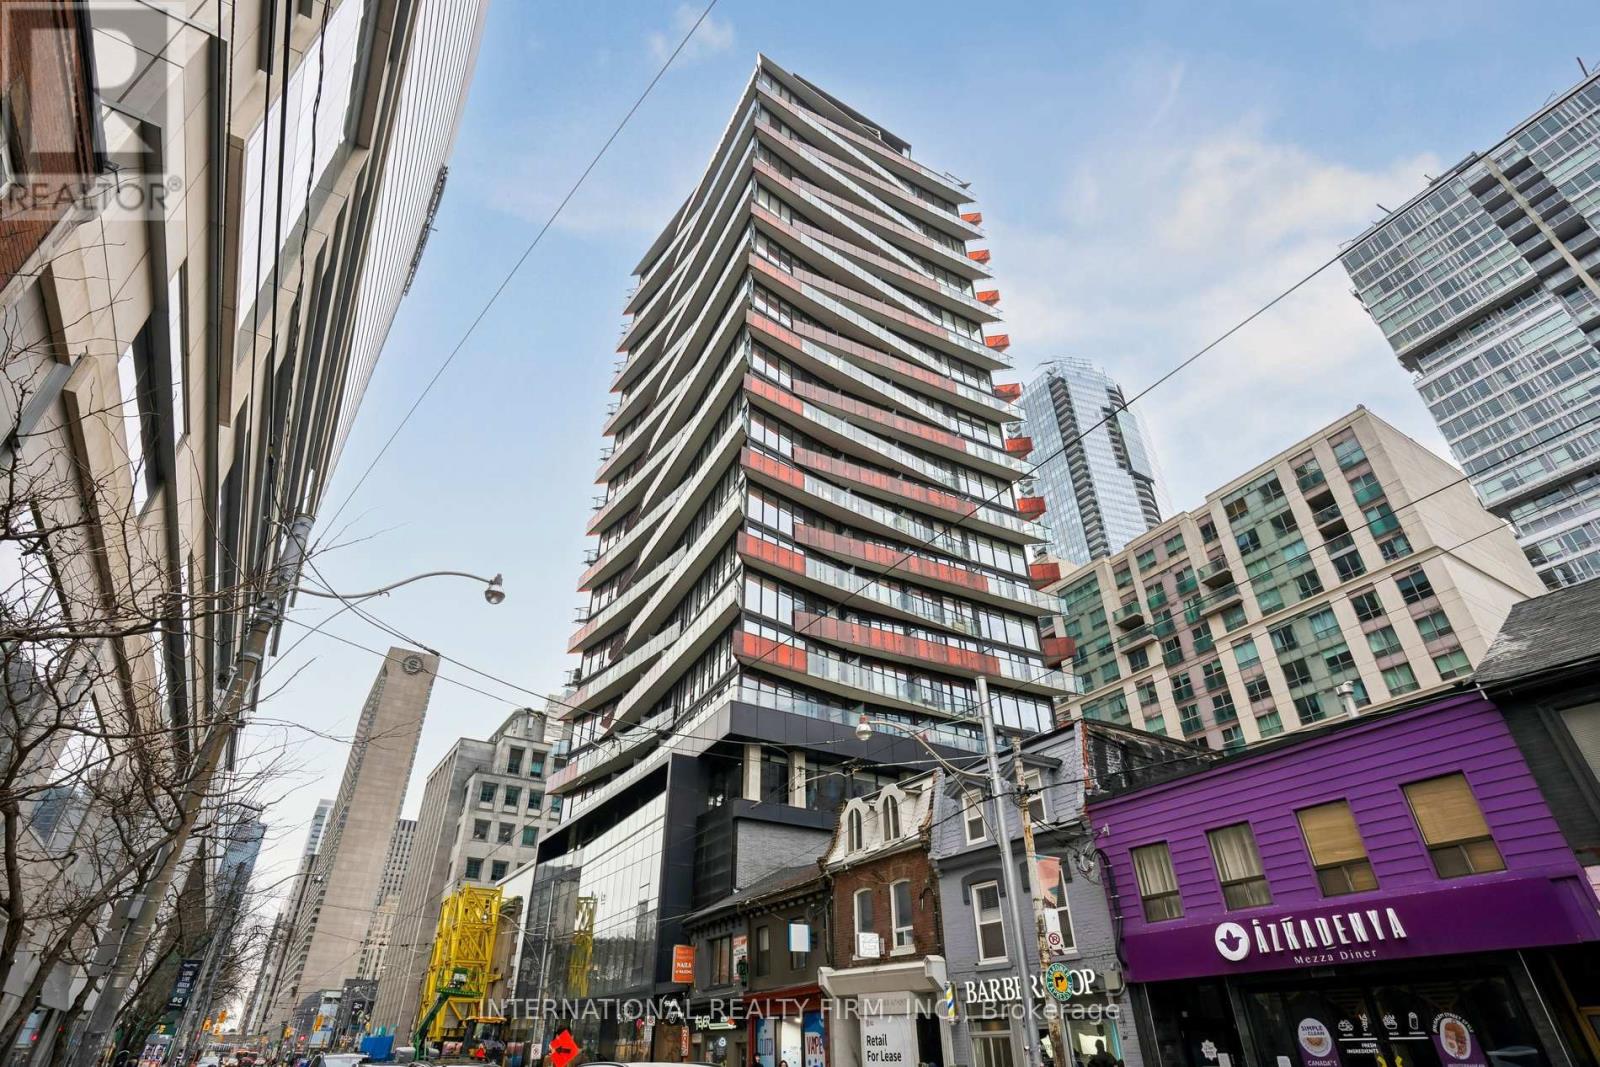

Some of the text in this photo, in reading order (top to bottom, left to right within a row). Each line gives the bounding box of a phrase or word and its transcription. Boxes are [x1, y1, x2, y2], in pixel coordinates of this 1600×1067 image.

[1293, 949, 1378, 965] Mezza Diner
[965, 969, 1096, 1004] BARBEROP
[805, 1035, 824, 1056] VAPE
[866, 1033, 888, 1047] Retail
[867, 1050, 902, 1063] For Lease
